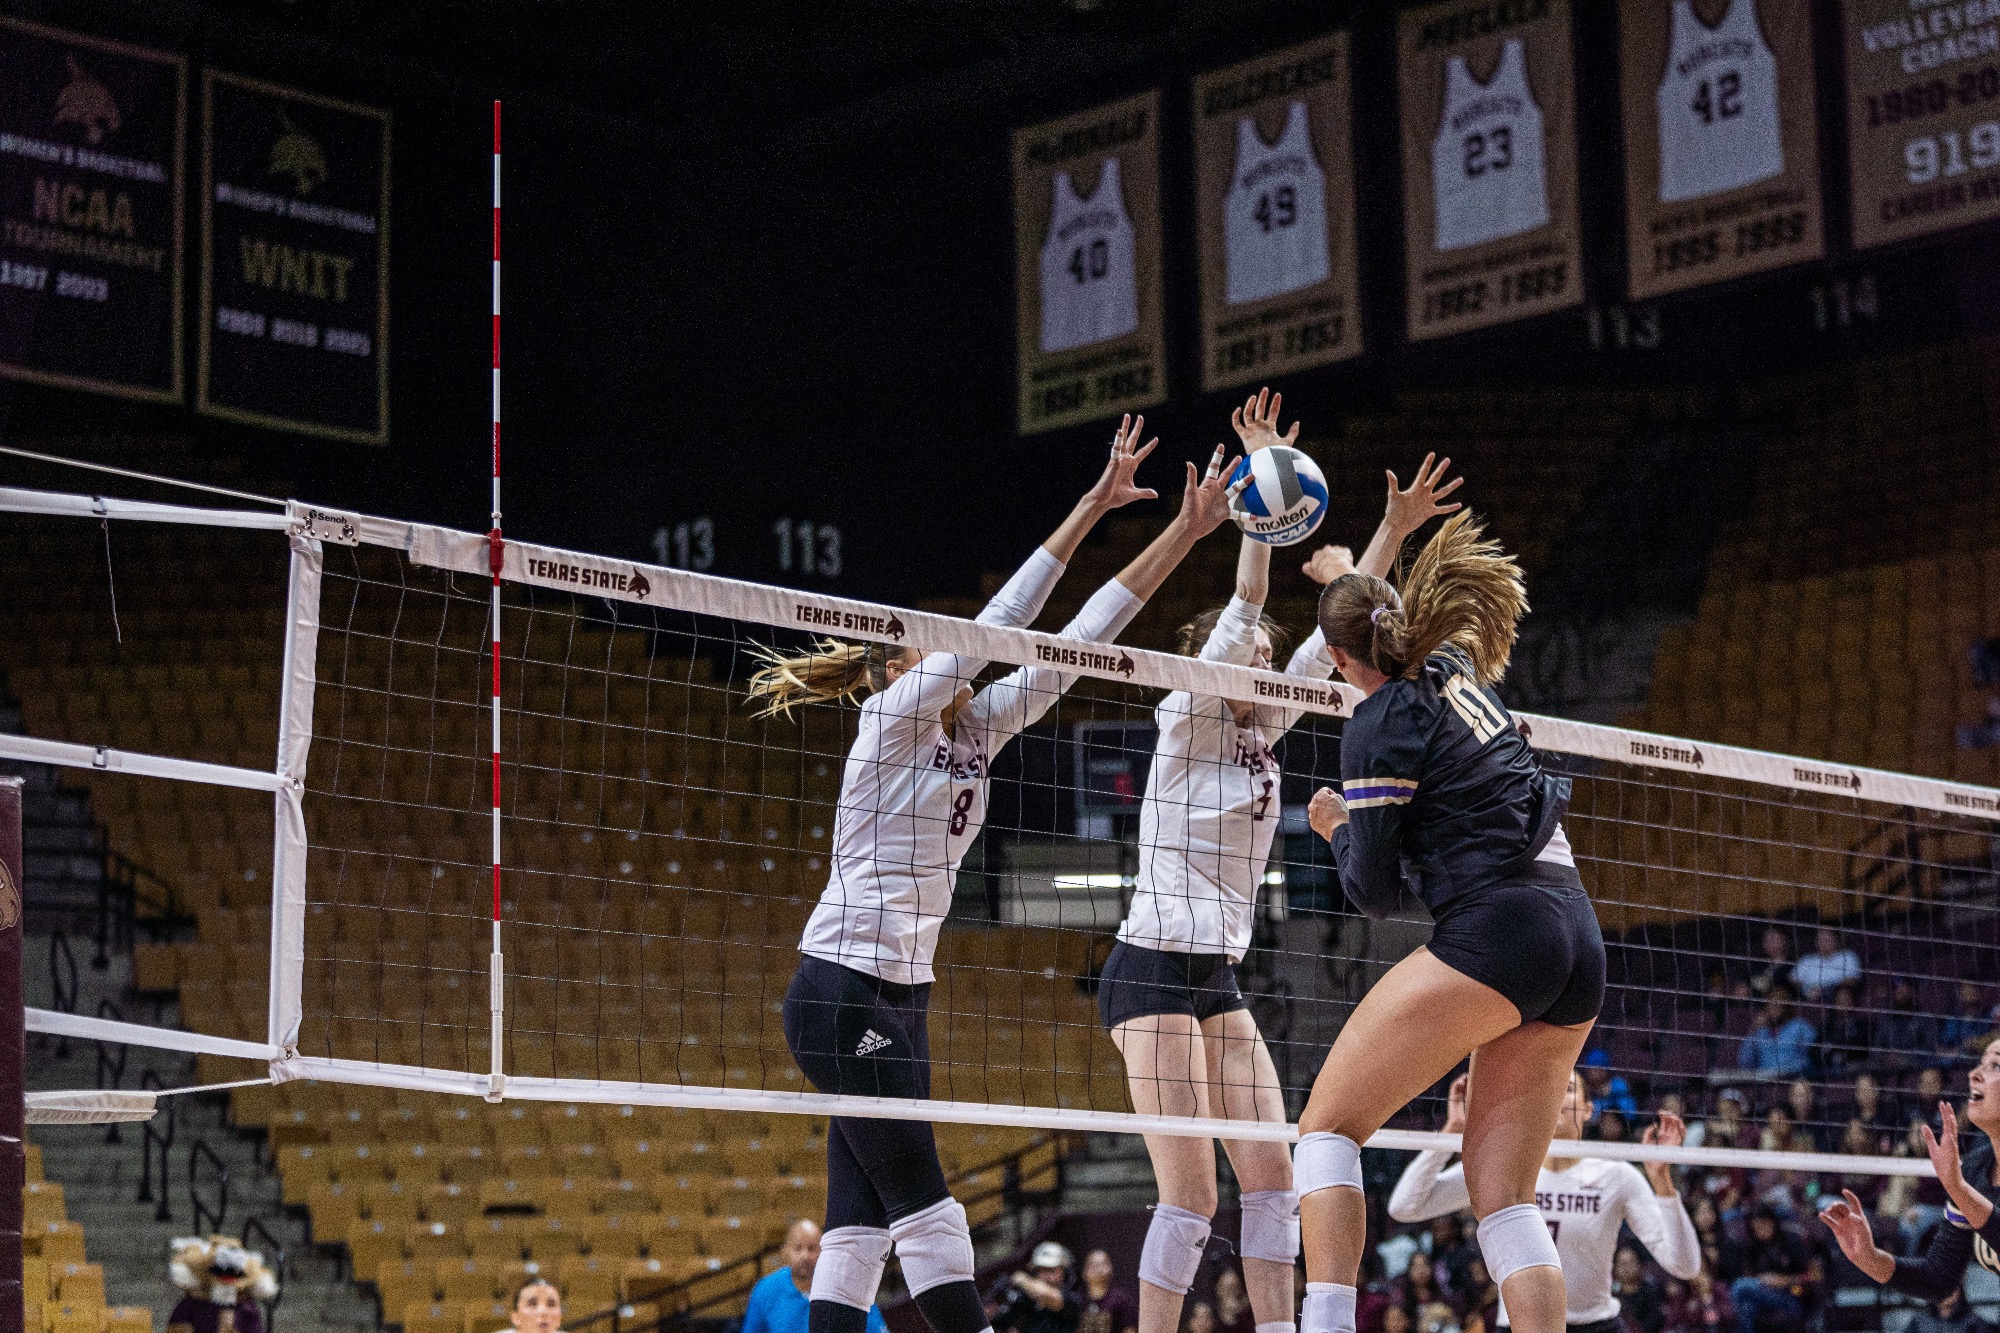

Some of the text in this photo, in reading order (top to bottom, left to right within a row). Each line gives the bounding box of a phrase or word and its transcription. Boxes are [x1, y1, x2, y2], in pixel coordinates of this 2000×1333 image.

[1901, 25, 1999, 75] COACH
[1692, 69, 1743, 125] 42
[1463, 126, 1511, 178] 23
[1903, 120, 2000, 184] 919
[33, 175, 136, 237] NCAA
[1255, 185, 1298, 233] 49
[239, 235, 355, 303] WNIT
[1067, 237, 1108, 286] 40
[1809, 271, 1879, 333] 114
[317, 512, 348, 525] Senoh
[1255, 504, 1310, 532] molten
[1265, 520, 1310, 544] NCAA
[653, 515, 716, 571] 113
[771, 515, 843, 579] 113
[528, 558, 628, 592] TEXAS STATE
[795, 604, 885, 634] TEXAS STATE
[1036, 644, 1117, 673] TEXAS STATE
[1253, 679, 1327, 706] TEXAS STATE
[1437, 672, 1509, 746] 10
[1629, 741, 1691, 764] TEXAS STATE
[1793, 768, 1849, 789] TEXAS STATE
[949, 788, 975, 837] 8
[855, 1038, 893, 1056] adidas
[1557, 1194, 1601, 1214] STATE
